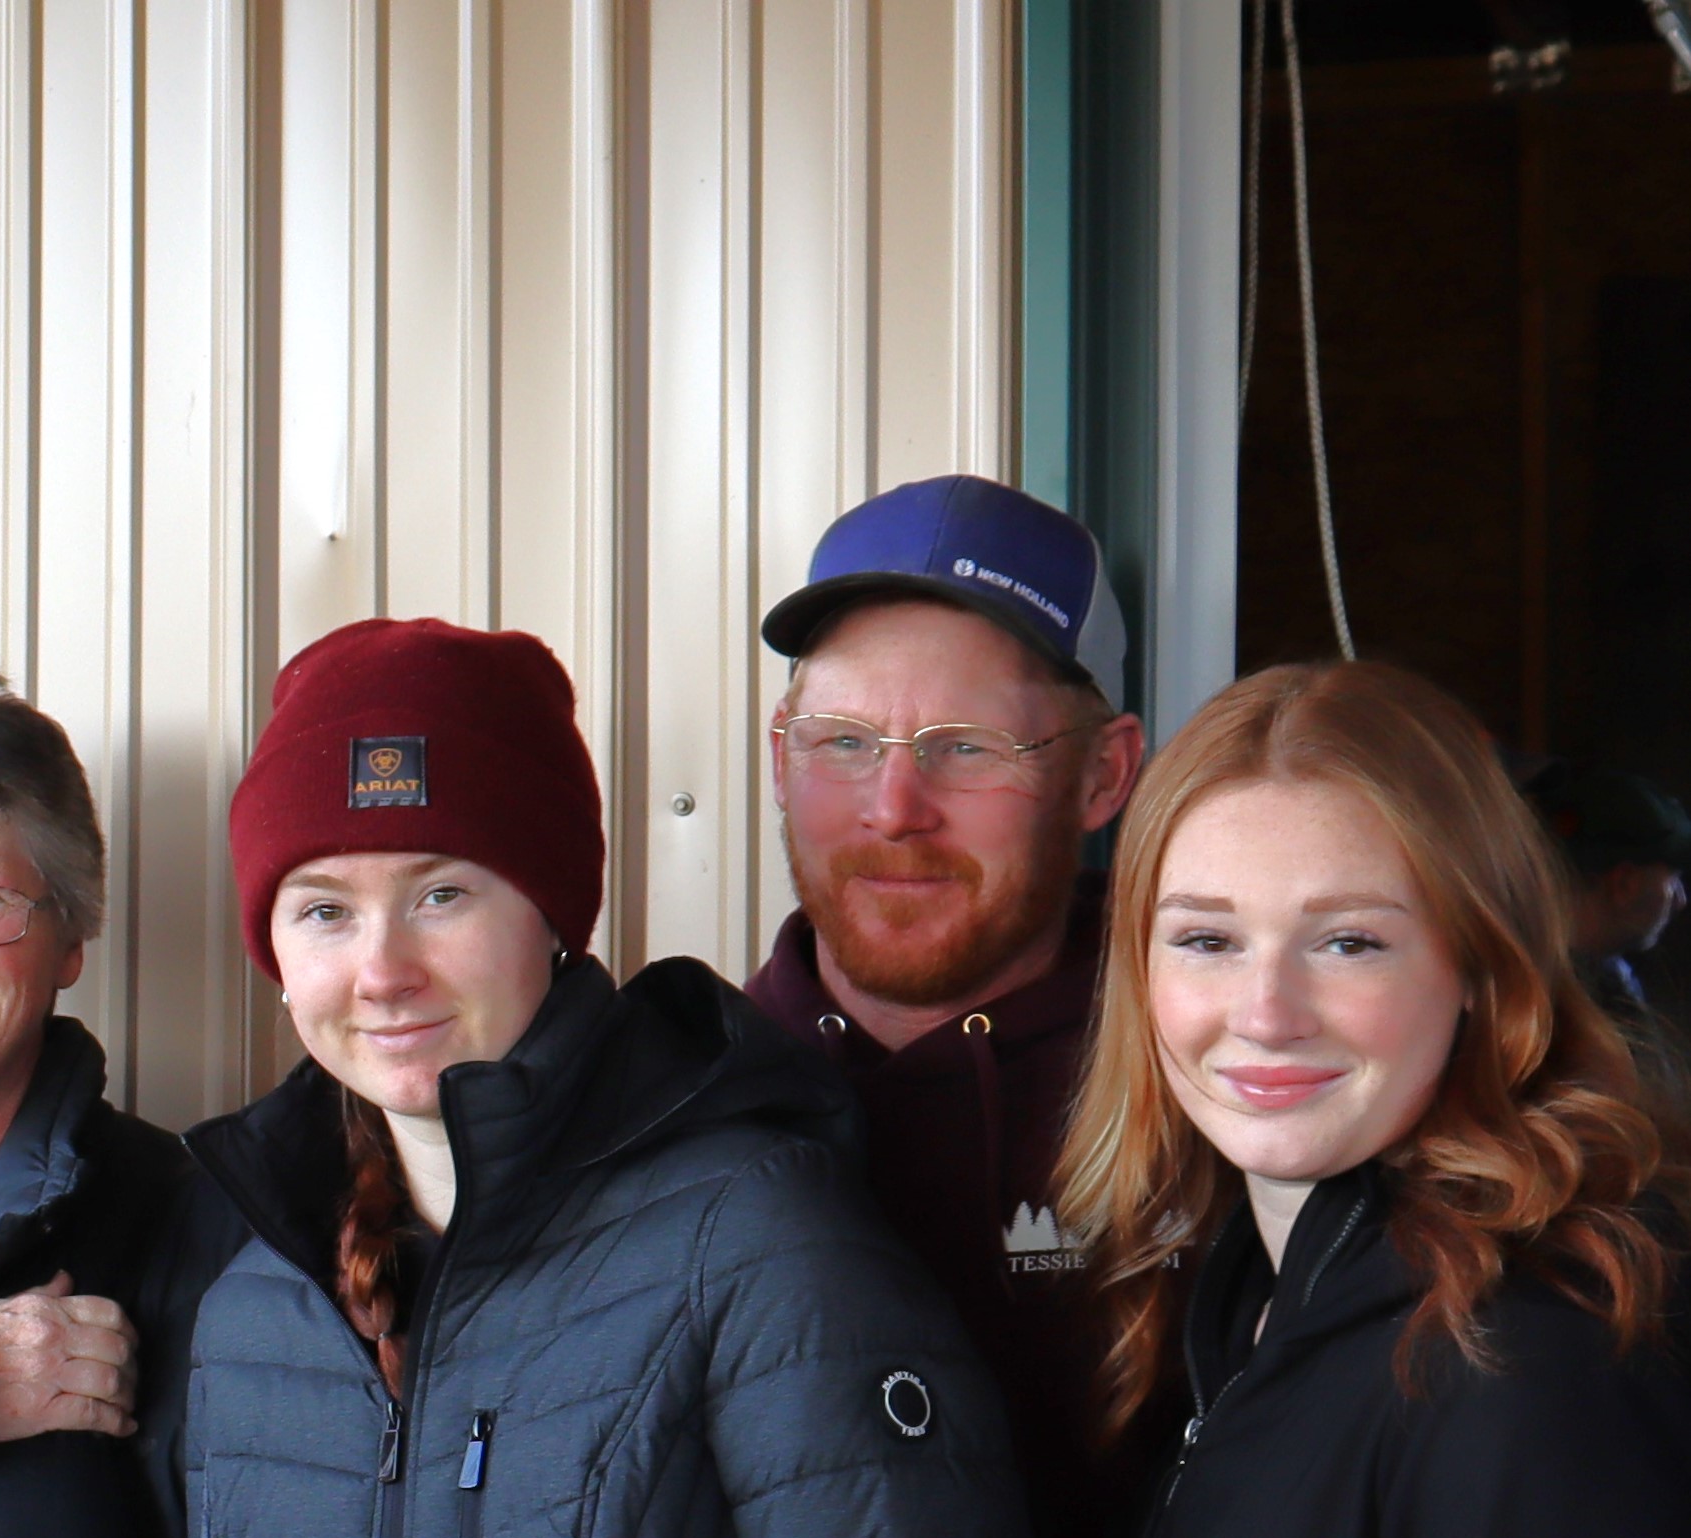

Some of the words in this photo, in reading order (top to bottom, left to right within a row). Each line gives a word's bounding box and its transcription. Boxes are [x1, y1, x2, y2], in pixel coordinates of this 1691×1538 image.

[977, 567, 1013, 589] NEW
[1013, 581, 1070, 629] HOLLAND
[354, 779, 421, 794] ARIAT
